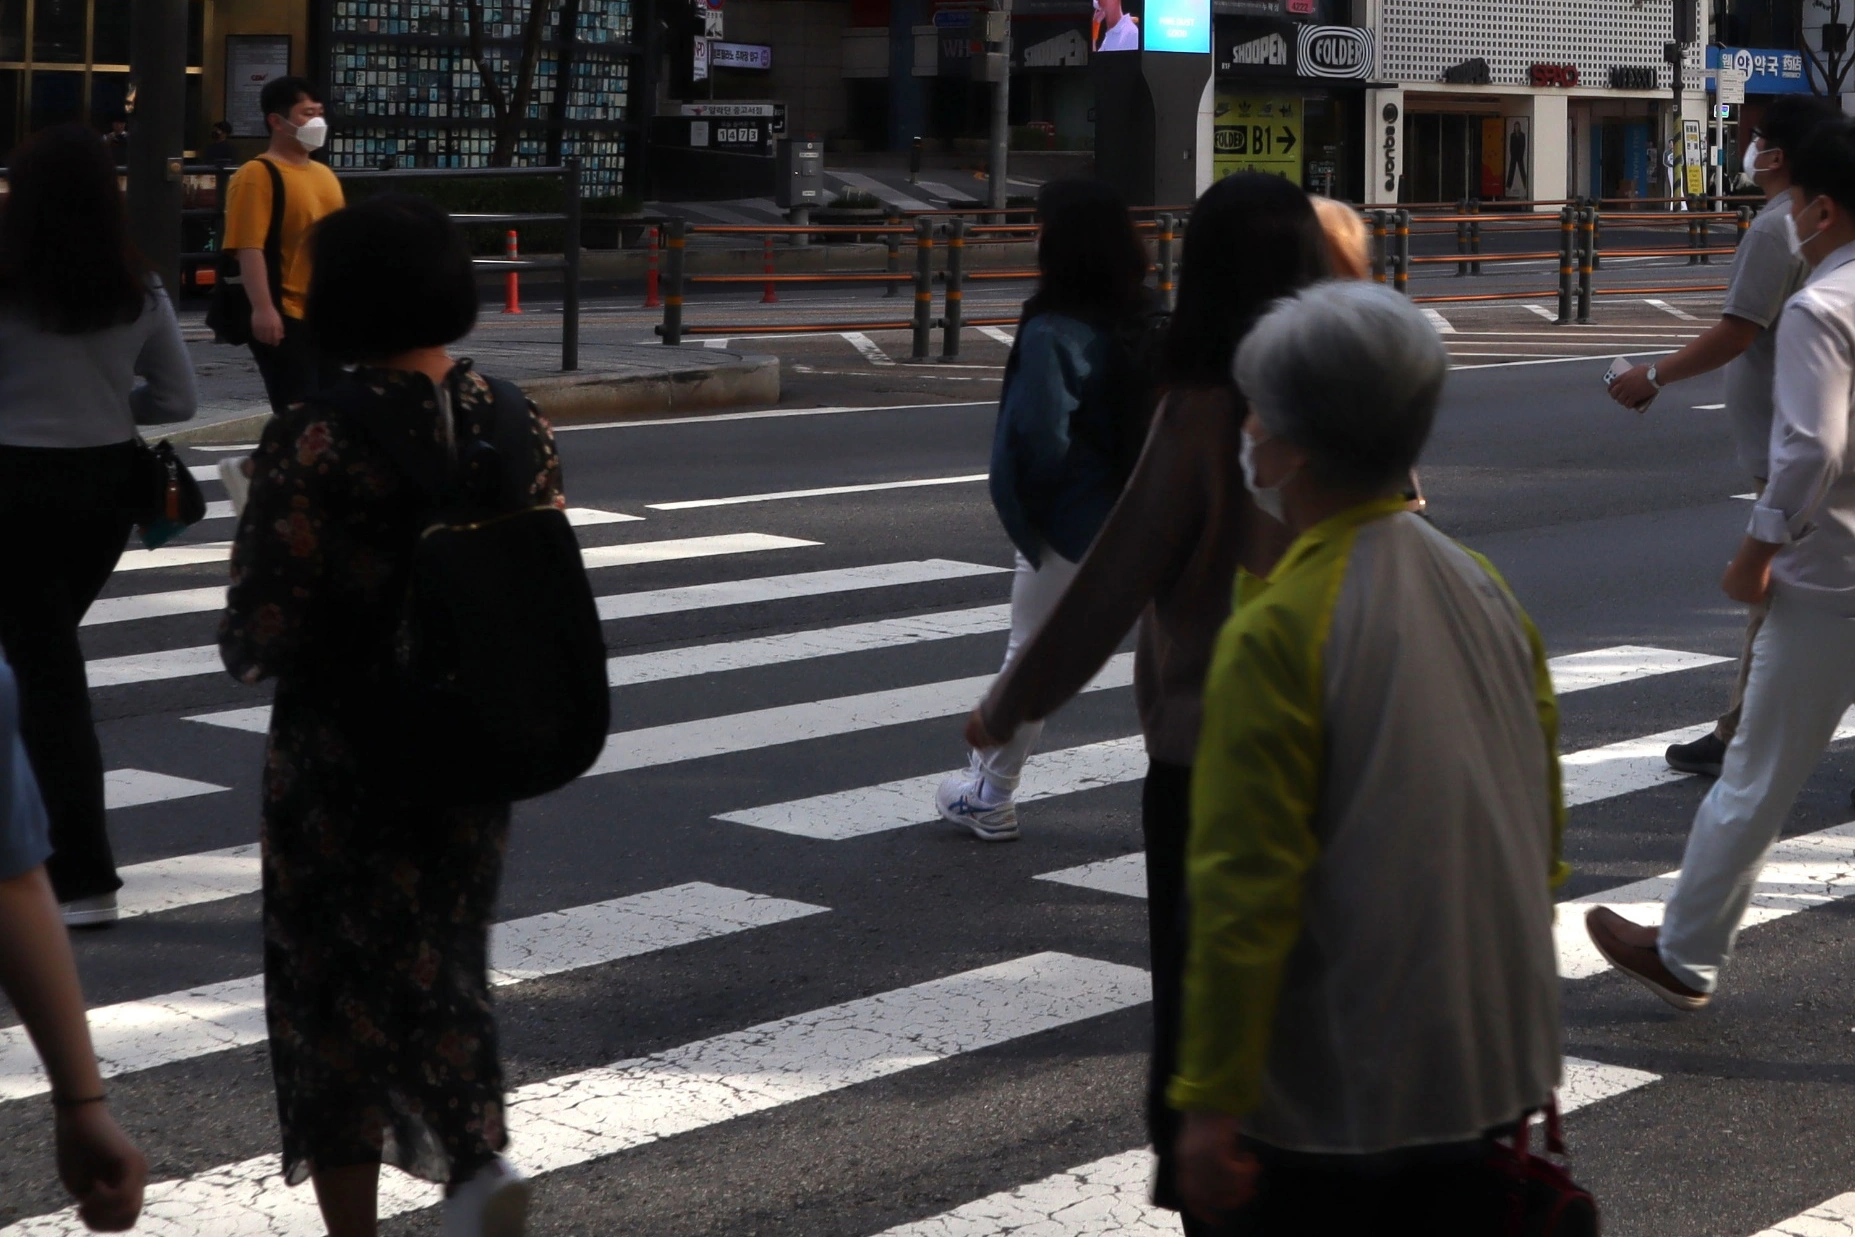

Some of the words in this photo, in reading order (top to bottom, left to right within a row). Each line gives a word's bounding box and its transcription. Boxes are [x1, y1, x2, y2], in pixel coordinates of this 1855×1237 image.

[1232, 31, 1287, 65] SHOOPEN
[1315, 38, 1364, 65] FOLDER
[1531, 64, 1579, 87] SPAO
[1754, 54, 1779, 76] 약국
[709, 106, 731, 115] 알라딘
[733, 106, 763, 115] 중고서점
[718, 128, 758, 142] 1473
[1214, 131, 1244, 148] FOLDER
[1252, 125, 1271, 155] B1
